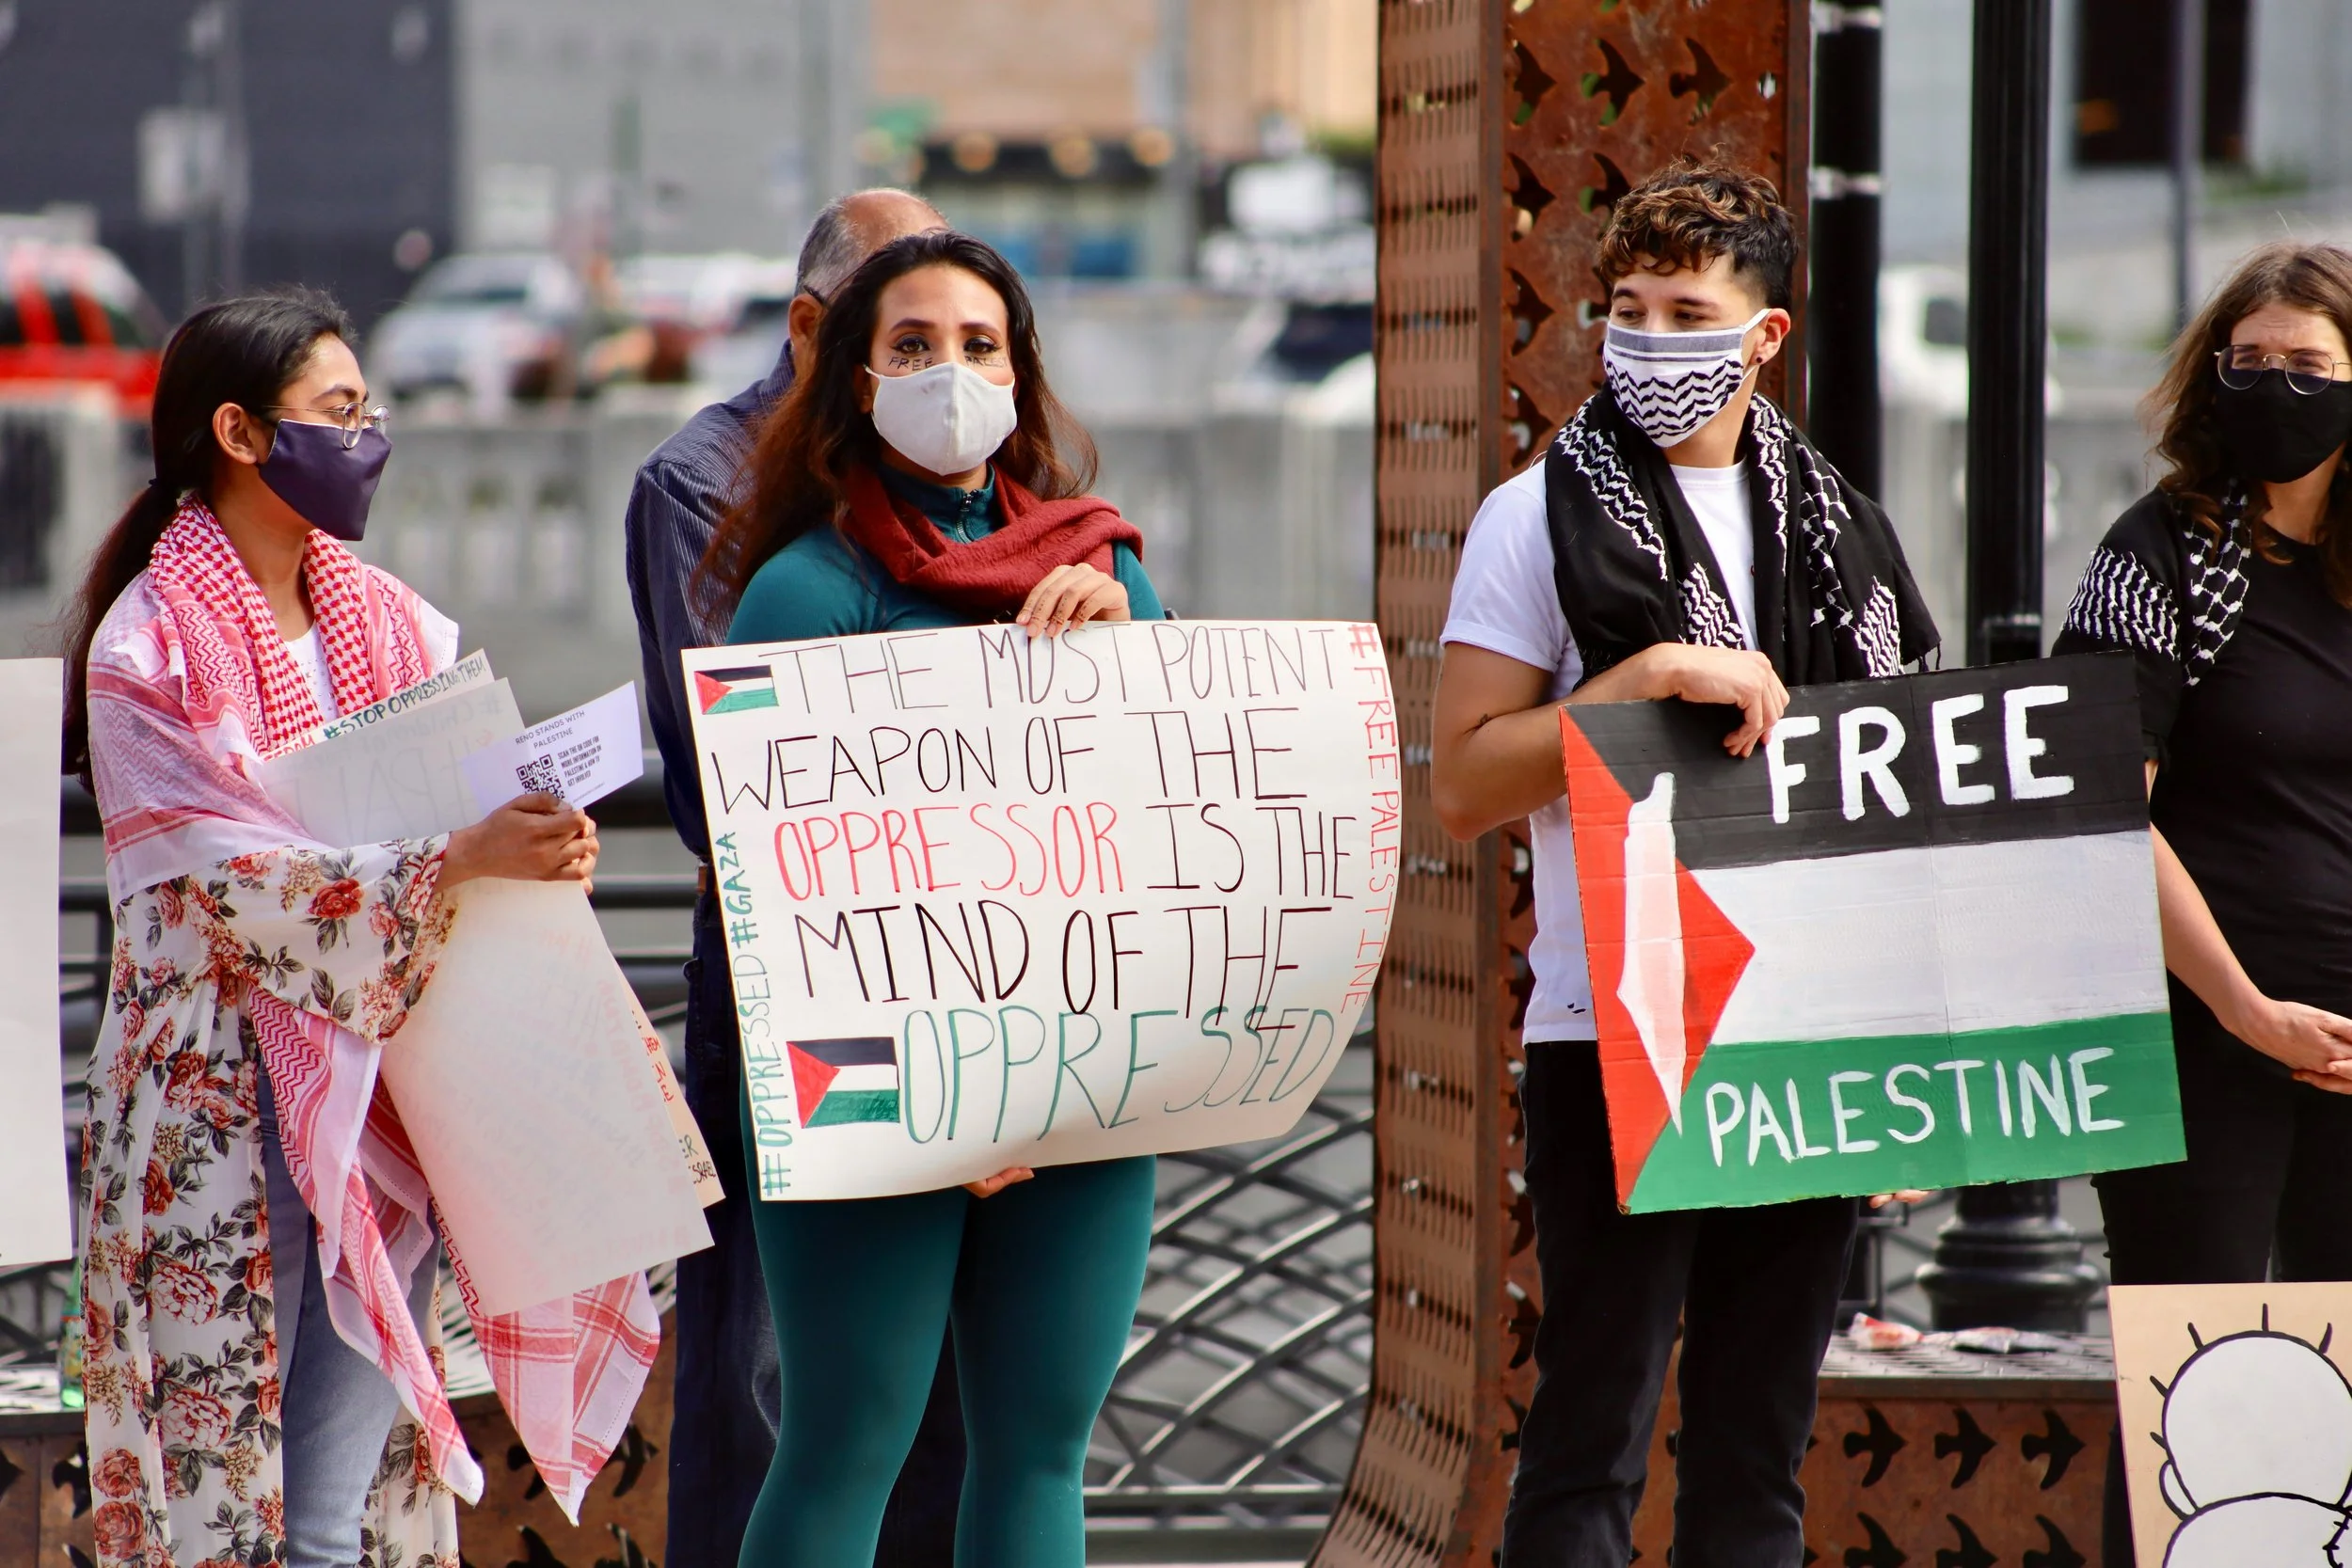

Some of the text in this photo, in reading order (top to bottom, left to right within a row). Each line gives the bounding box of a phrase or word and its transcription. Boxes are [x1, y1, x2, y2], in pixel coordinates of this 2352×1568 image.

[888, 356, 934, 371] FREE
[758, 623, 1334, 714] THE MOST POTENT
[515, 710, 585, 745] RENO STANDS WITH
[533, 727, 573, 749] PALESTINE
[564, 764, 584, 777] PALESTINE
[573, 748, 596, 764] INFORMATION
[583, 739, 593, 749] CODE
[711, 707, 1308, 815] WEAPON OF THE
[1766, 685, 2074, 825] FREE
[774, 801, 1357, 900] OPPRESSOR IS THE
[1341, 790, 1400, 1014] PALESTINE
[715, 832, 793, 1196] #OPPRESSED #GAZA
[794, 900, 1332, 1031] MIND OF THE
[903, 1005, 1335, 1145] OPPRESSED
[1704, 1047, 2125, 1167] PALESTINE
